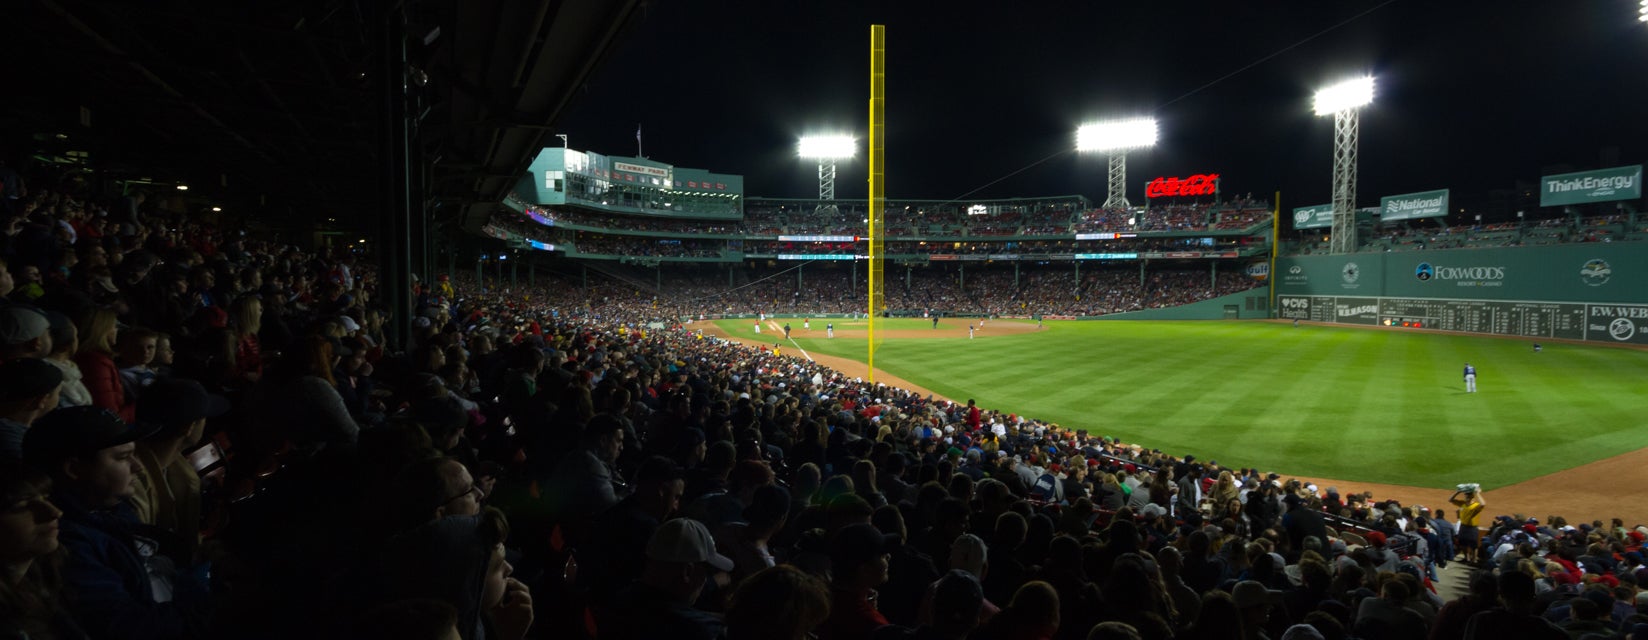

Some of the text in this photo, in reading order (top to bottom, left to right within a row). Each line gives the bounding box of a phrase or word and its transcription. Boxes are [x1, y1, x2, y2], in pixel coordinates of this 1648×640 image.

[1547, 176, 1633, 193] ThinkEnergy
[1399, 195, 1443, 211] National
[1248, 264, 1268, 274] Gulf
[1290, 298, 1308, 308] CVS
[1283, 308, 1308, 318] Health
